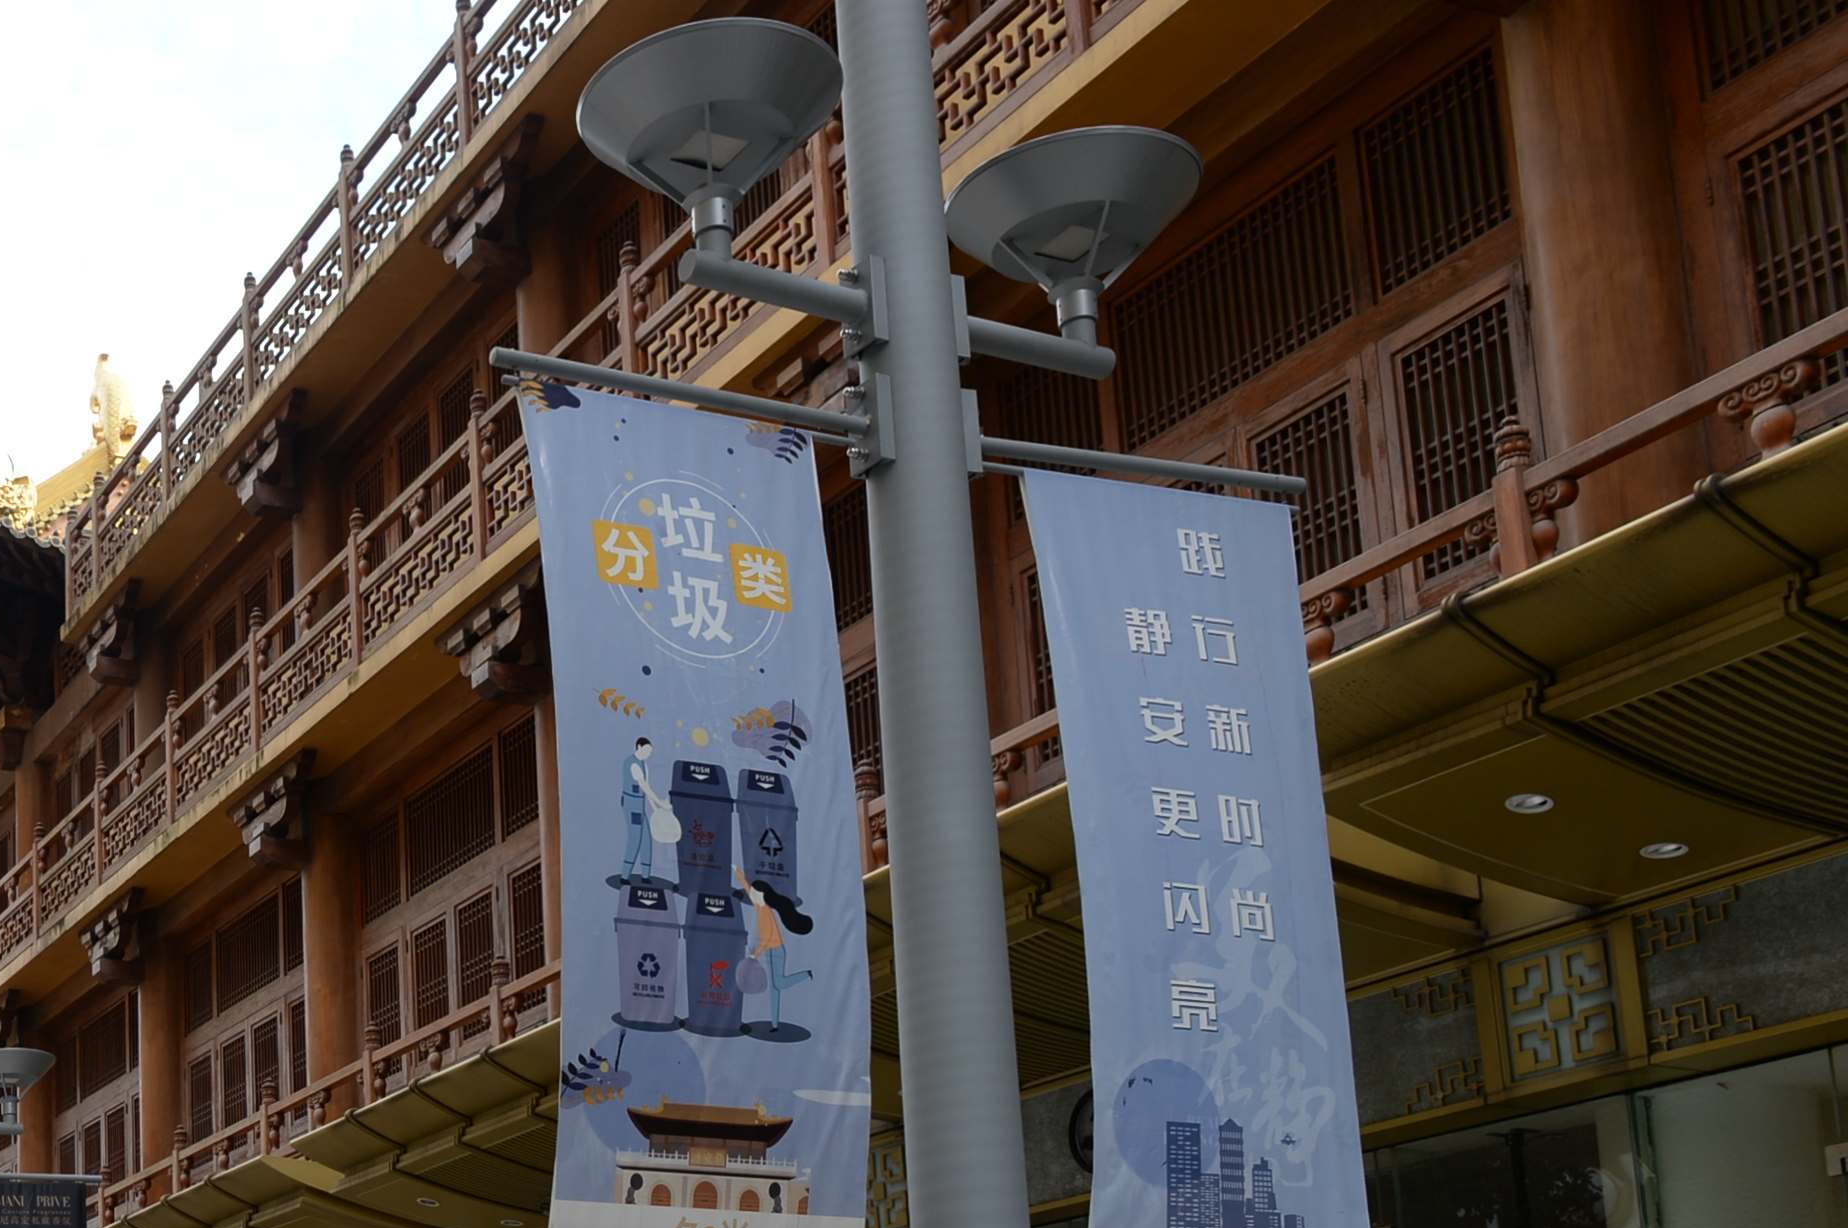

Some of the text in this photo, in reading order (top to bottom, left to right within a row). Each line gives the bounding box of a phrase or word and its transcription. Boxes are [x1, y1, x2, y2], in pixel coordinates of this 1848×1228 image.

[656, 492, 734, 645] 垃圾
[1175, 527, 1277, 943] 践行新时尚
[690, 765, 711, 775] PUSH
[755, 773, 775, 783] PUSH
[1122, 605, 1220, 1034] 静安更闪亮
[637, 890, 658, 899] PUSH
[704, 897, 725, 906] PUSH
